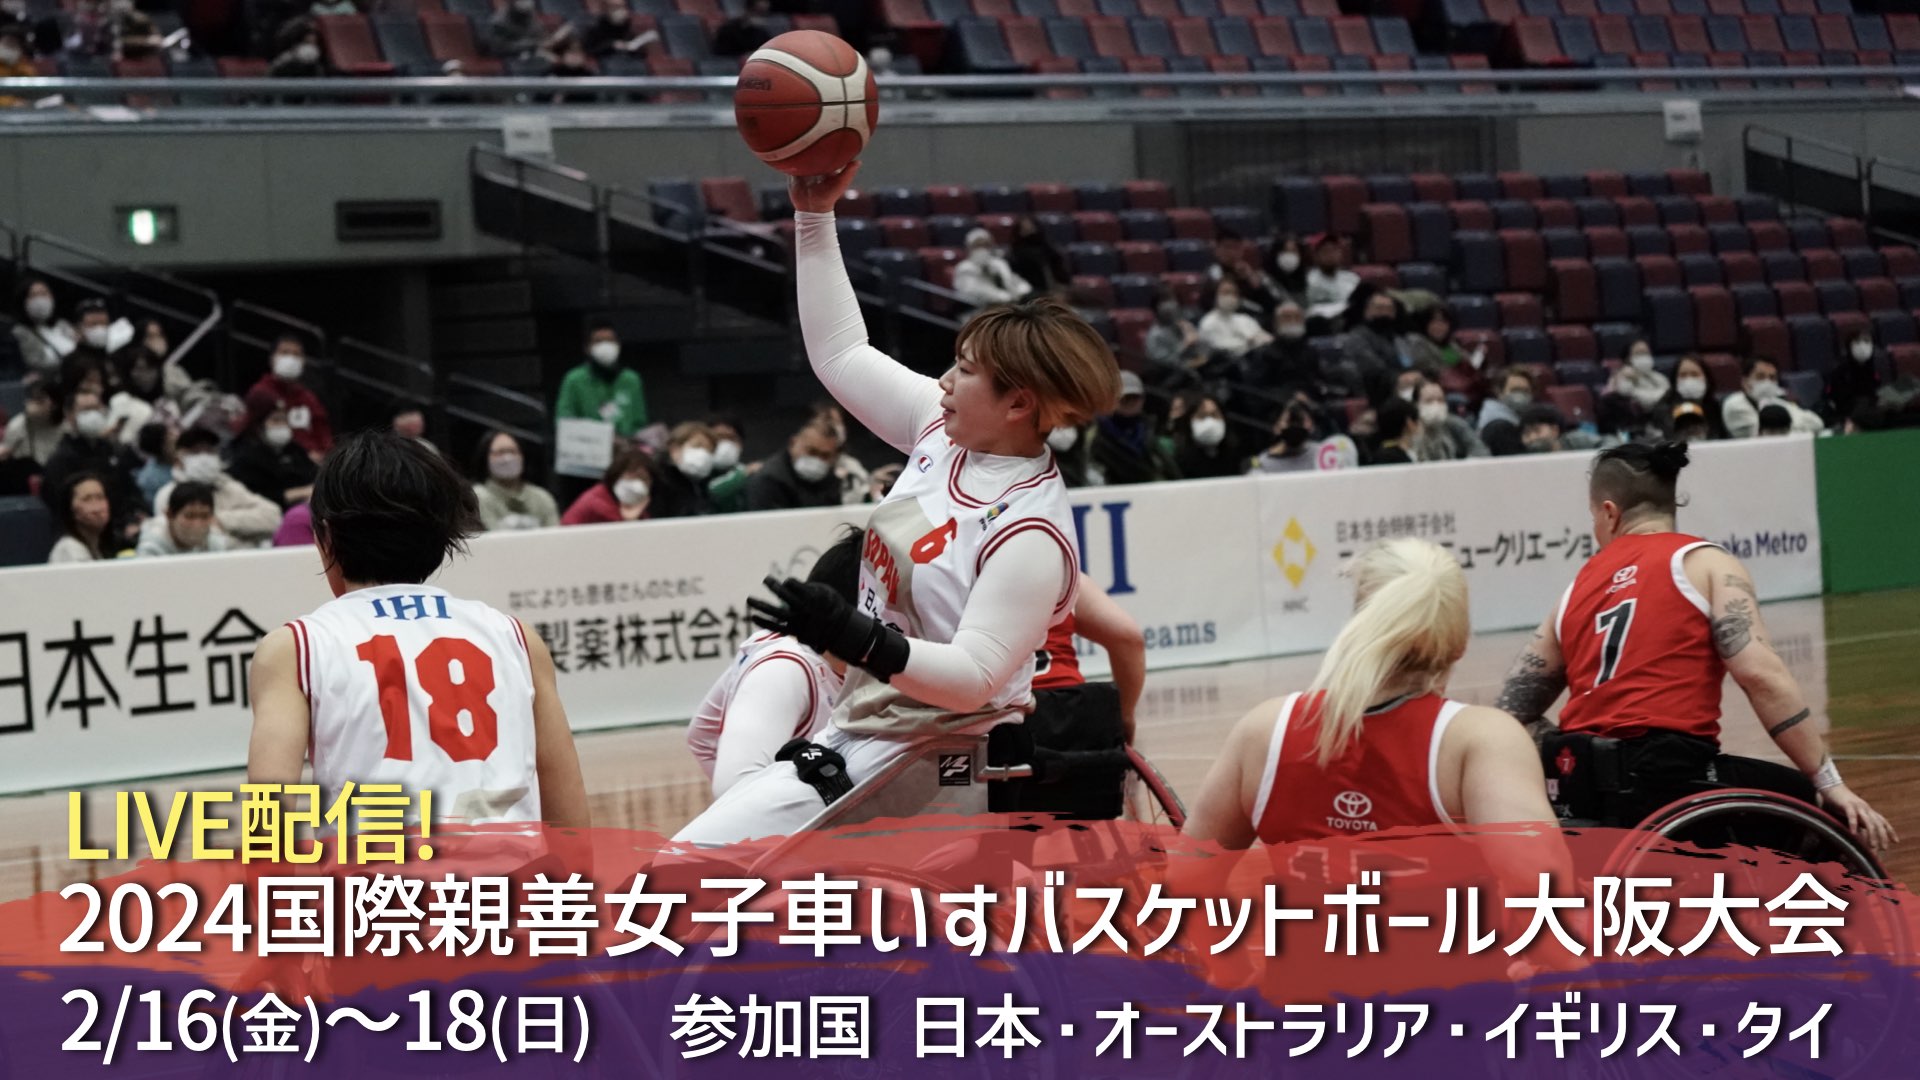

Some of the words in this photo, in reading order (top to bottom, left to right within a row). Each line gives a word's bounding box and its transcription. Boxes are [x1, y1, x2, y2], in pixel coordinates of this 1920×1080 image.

[1755, 531, 1808, 556] Metro
[371, 595, 452, 620] IHI
[0, 608, 267, 733] 日本生命
[1594, 598, 1637, 688] 7
[355, 634, 498, 763] 18
[1326, 816, 1378, 832] TOYOTA
